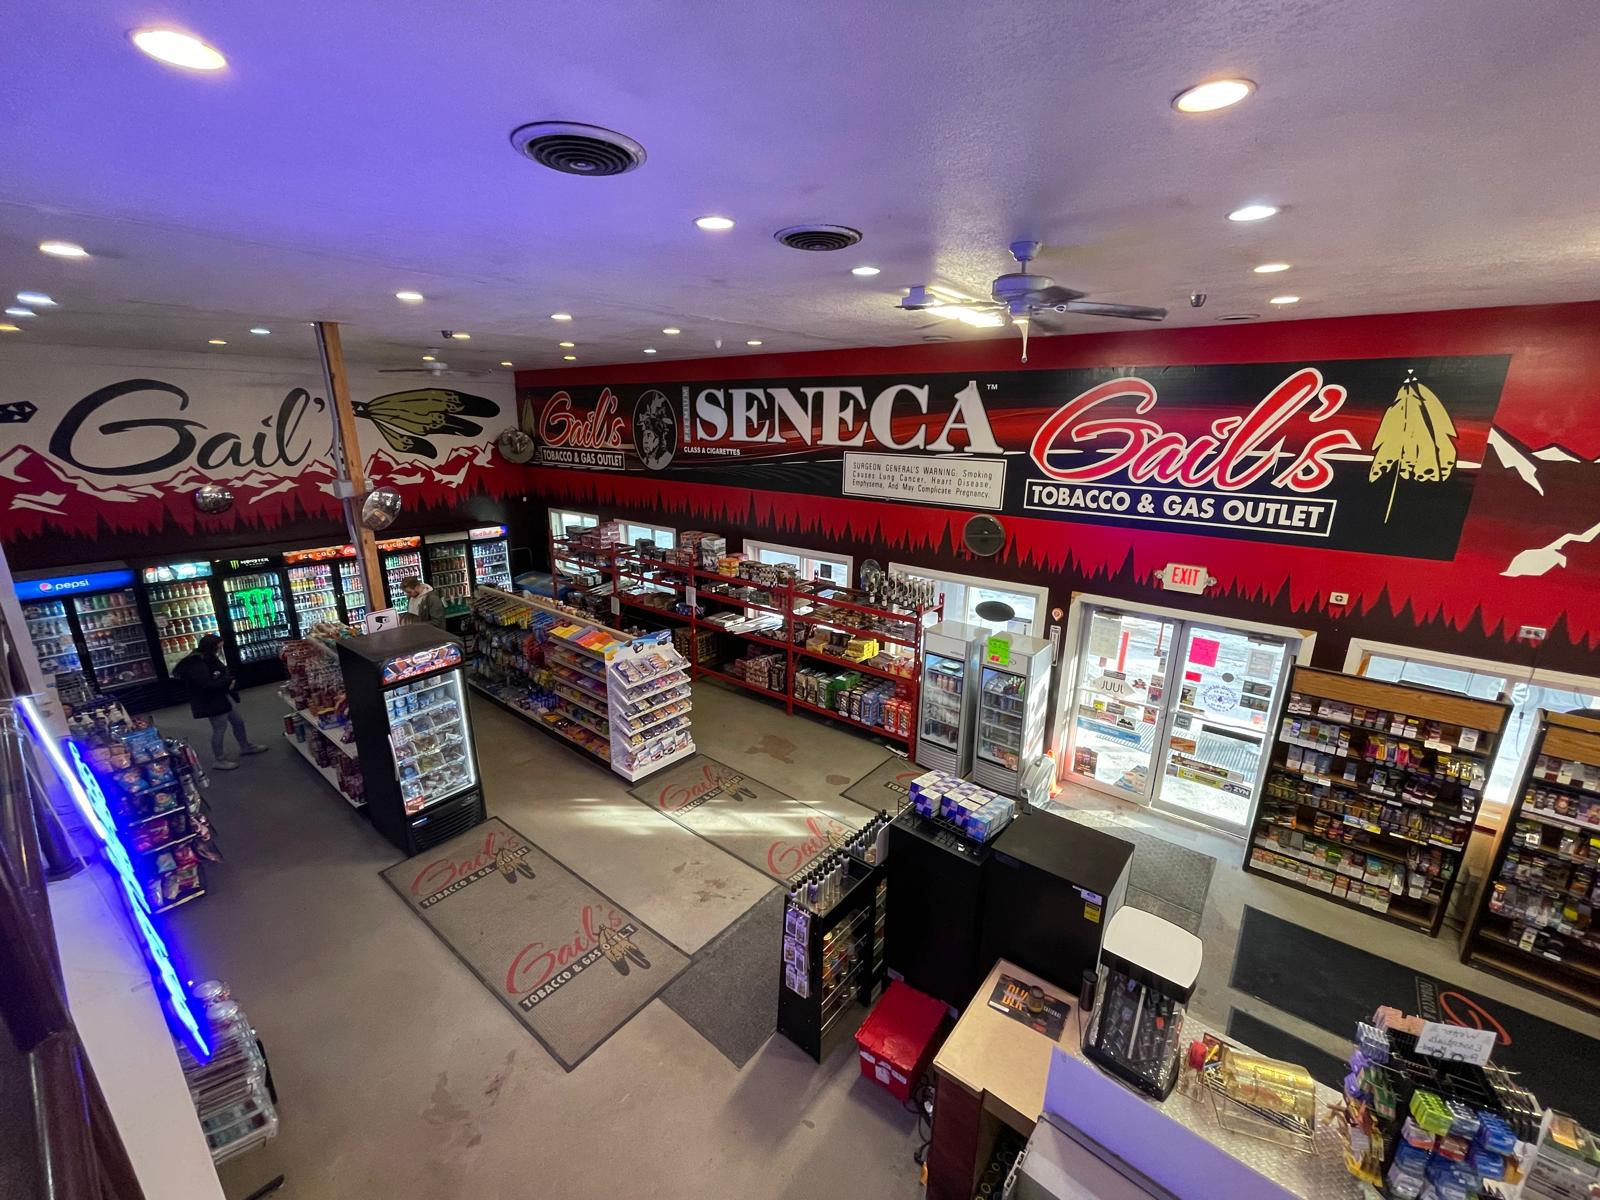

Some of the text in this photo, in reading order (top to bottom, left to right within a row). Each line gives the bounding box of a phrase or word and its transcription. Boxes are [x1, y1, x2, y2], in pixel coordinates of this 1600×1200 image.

[49, 378, 346, 476] Gail'
[540, 387, 626, 448] Gail's
[695, 379, 1004, 455] SENECA
[1029, 367, 1361, 492] Gail's
[543, 449, 622, 466] TOBACCO & GAS OUTLET
[683, 446, 701, 454] CLASS
[706, 447, 741, 456] CIGARETTES
[852, 471, 992, 489] Causes Lung Cancer, Heart Disease,
[853, 462, 882, 471] SURGEON
[885, 464, 920, 474] GENERAL'S
[962, 469, 993, 480] Smoking
[852, 479, 990, 499] Emphysema, And May Complicate Pregnancy.
[1032, 485, 1324, 528] TOBACCO & GAS OUTLET
[55, 578, 89, 592] pepsi
[1171, 566, 1201, 587] EXIT
[1233, 784, 1249, 796] ZYN
[410, 831, 521, 897] Gail's
[422, 879, 468, 908] TOBACCO
[505, 903, 624, 995] Gail's
[522, 971, 572, 1009] TOBACCO
[572, 964, 583, 973] &
[583, 949, 601, 966] GAS
